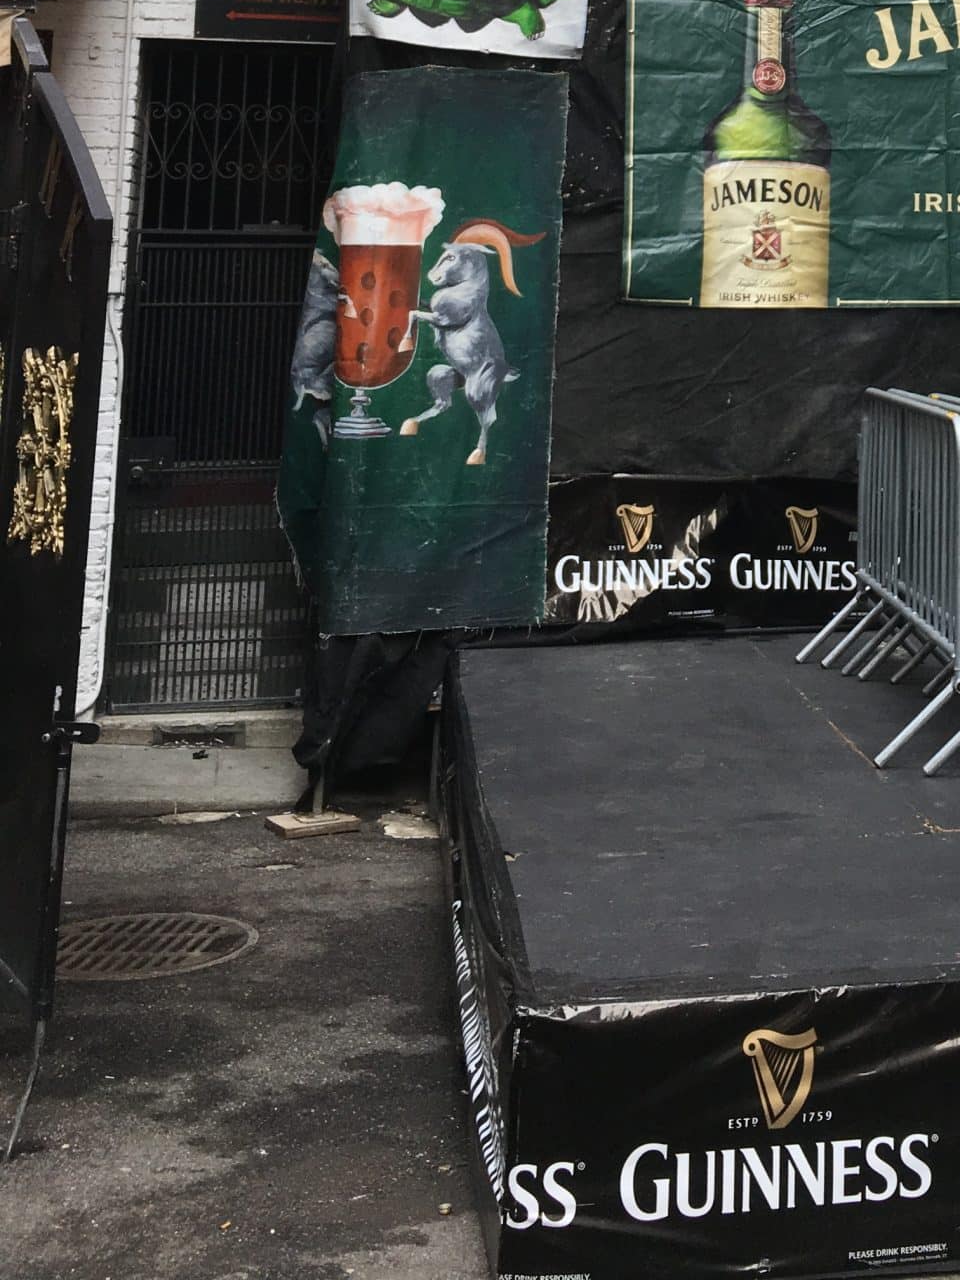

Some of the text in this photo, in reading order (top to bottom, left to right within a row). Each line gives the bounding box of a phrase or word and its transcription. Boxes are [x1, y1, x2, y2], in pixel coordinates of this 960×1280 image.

[711, 178, 823, 212] JAMESON
[719, 292, 752, 302] IRISH
[554, 555, 711, 593] GUINNESS
[802, 1110, 832, 1123] 1759
[619, 1133, 933, 1222] GUINNESS
[501, 1161, 578, 1230] SS
[848, 1250, 874, 1260] PLEASE
[876, 1248, 899, 1257] DRINK
